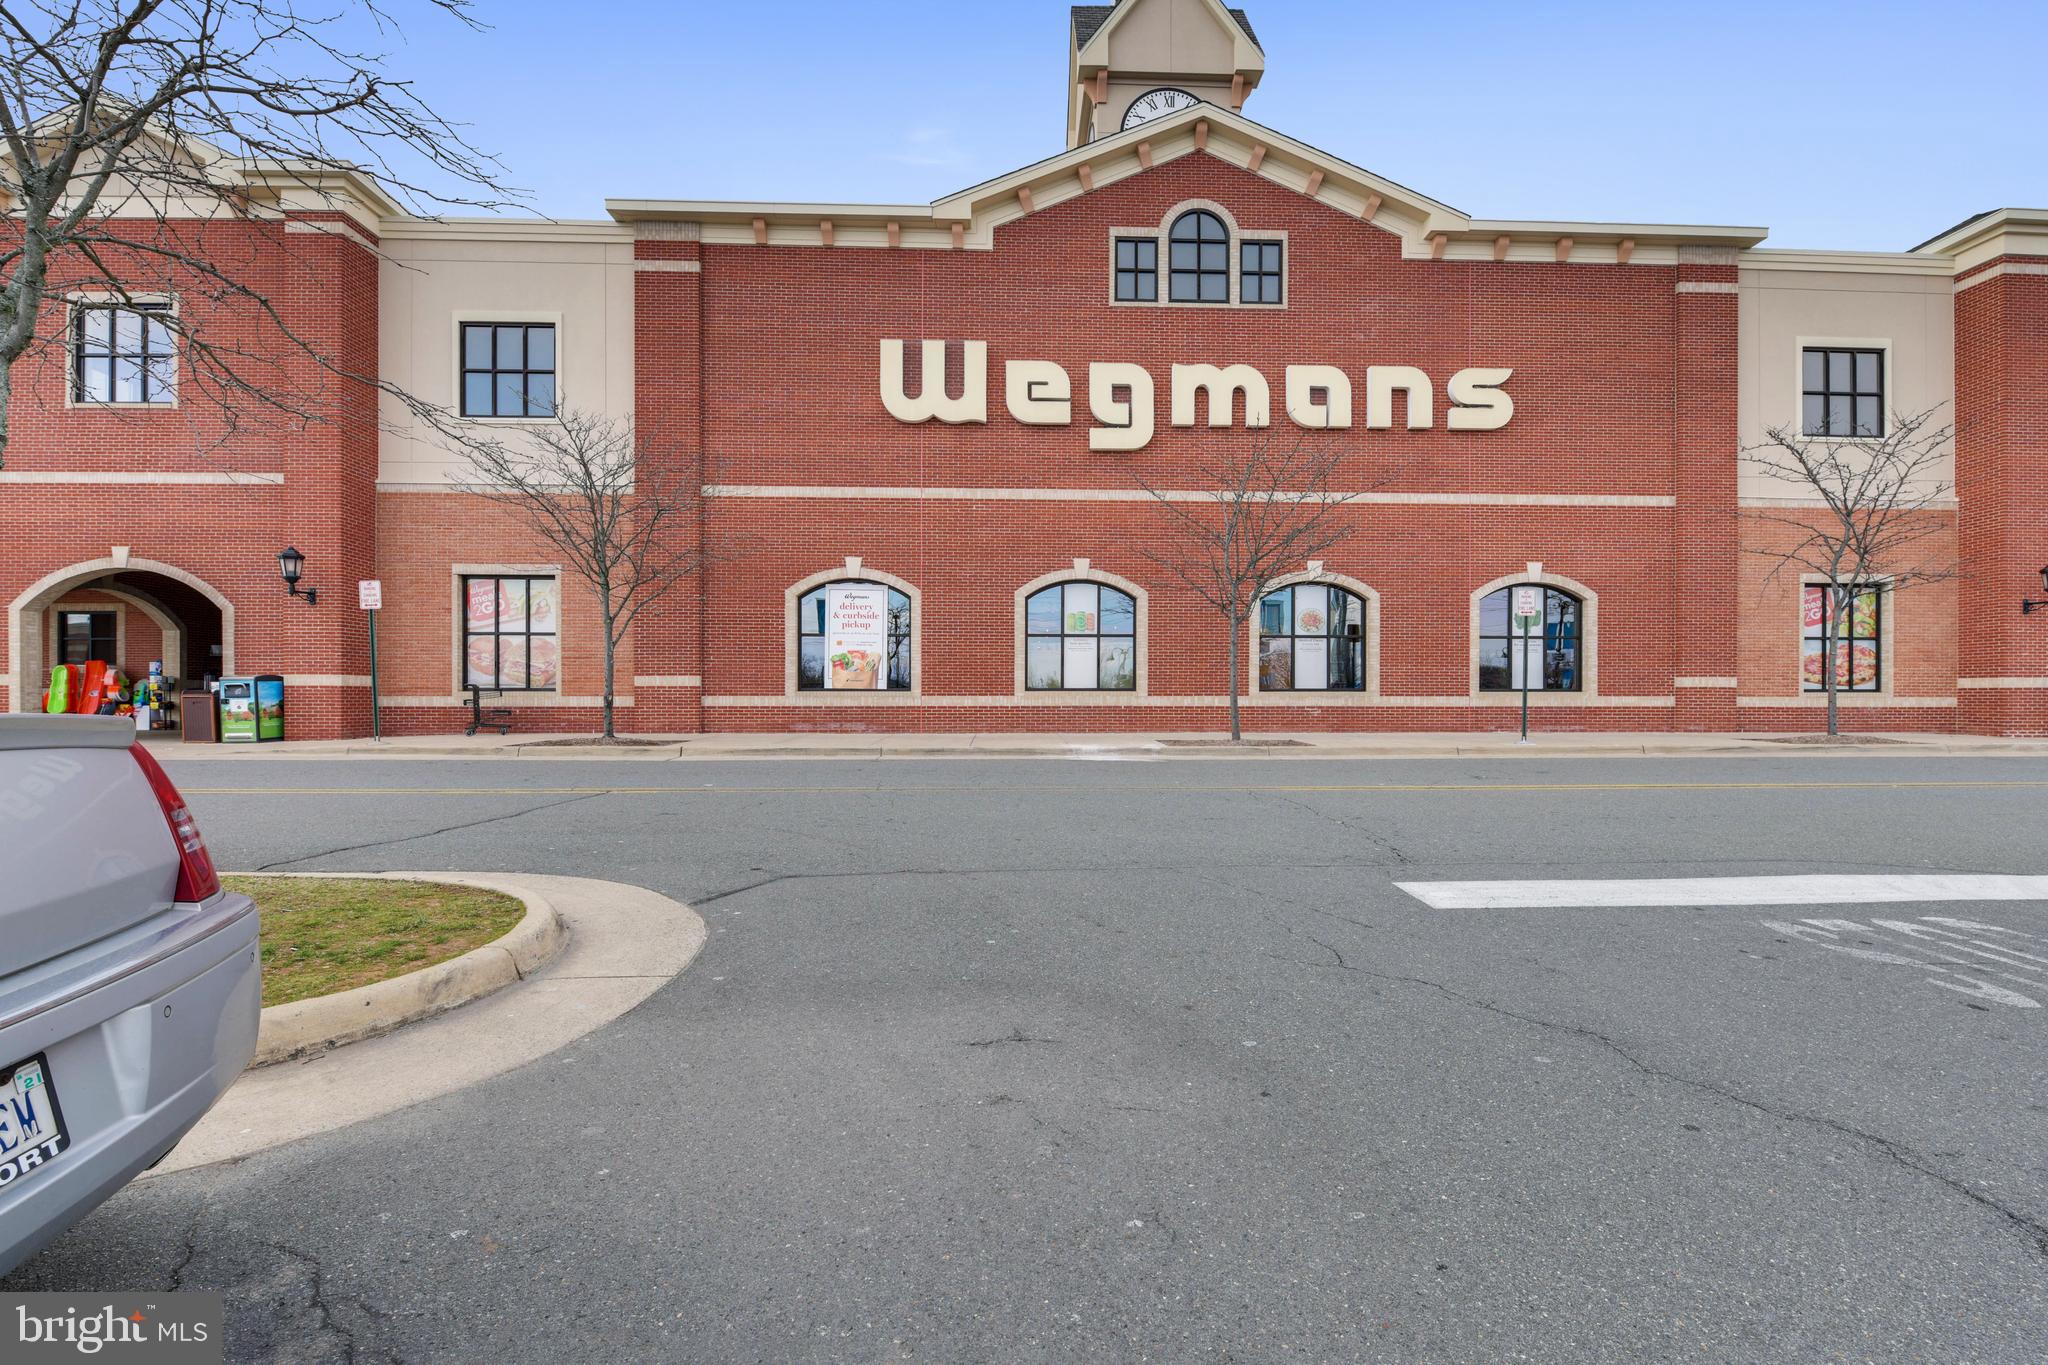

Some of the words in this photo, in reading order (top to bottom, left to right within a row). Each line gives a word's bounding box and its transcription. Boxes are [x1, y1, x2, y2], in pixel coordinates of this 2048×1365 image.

[1146, 98, 1158, 112] XI
[1164, 95, 1175, 108] XII
[880, 338, 1513, 451] Wegmans
[839, 602, 873, 613] delivery
[842, 611, 880, 619] curbside
[841, 620, 871, 630] pickup
[24, 1072, 42, 1089] 21
